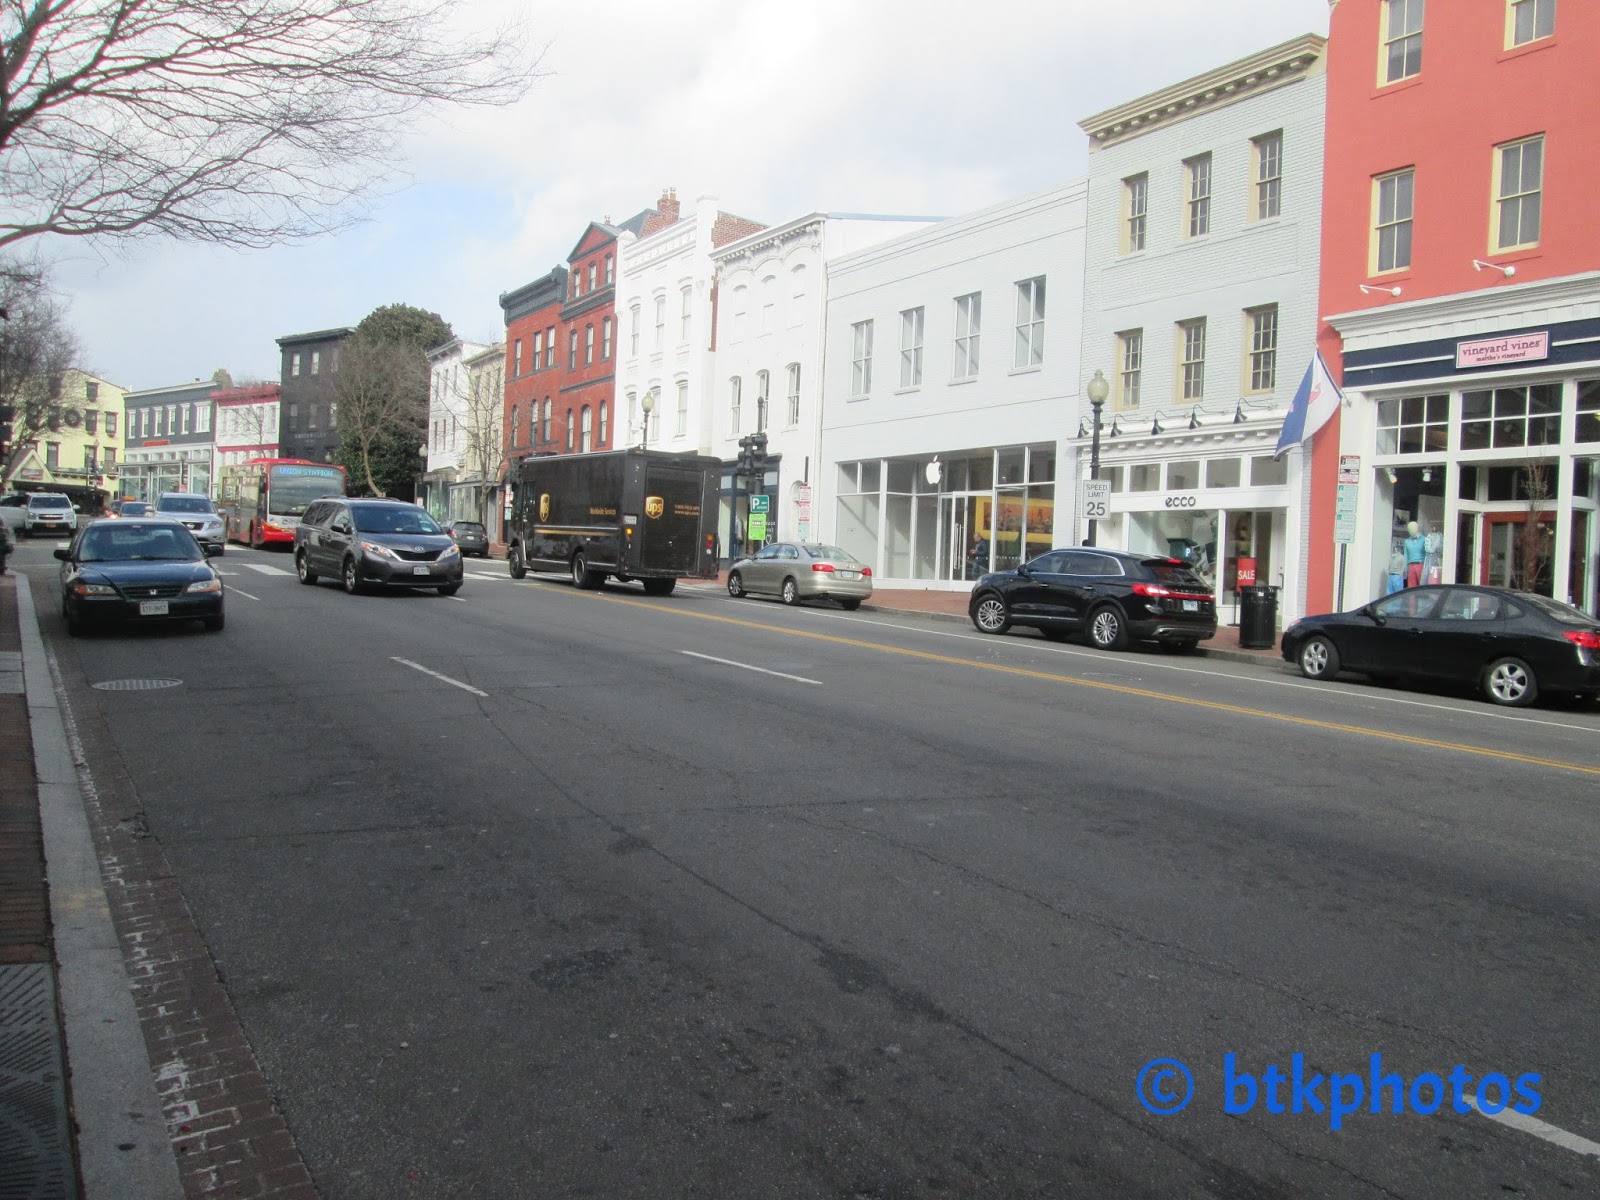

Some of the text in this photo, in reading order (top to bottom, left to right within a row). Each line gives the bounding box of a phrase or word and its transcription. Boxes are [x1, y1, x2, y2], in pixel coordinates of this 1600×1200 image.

[1462, 340, 1541, 356] vineyard vines
[1476, 351, 1526, 362] martha's vineyard
[280, 467, 333, 477] UNION STATION
[1165, 496, 1196, 508] ecco
[647, 503, 662, 515] ups
[1087, 501, 1106, 516] 25
[1238, 570, 1255, 580] SALE
